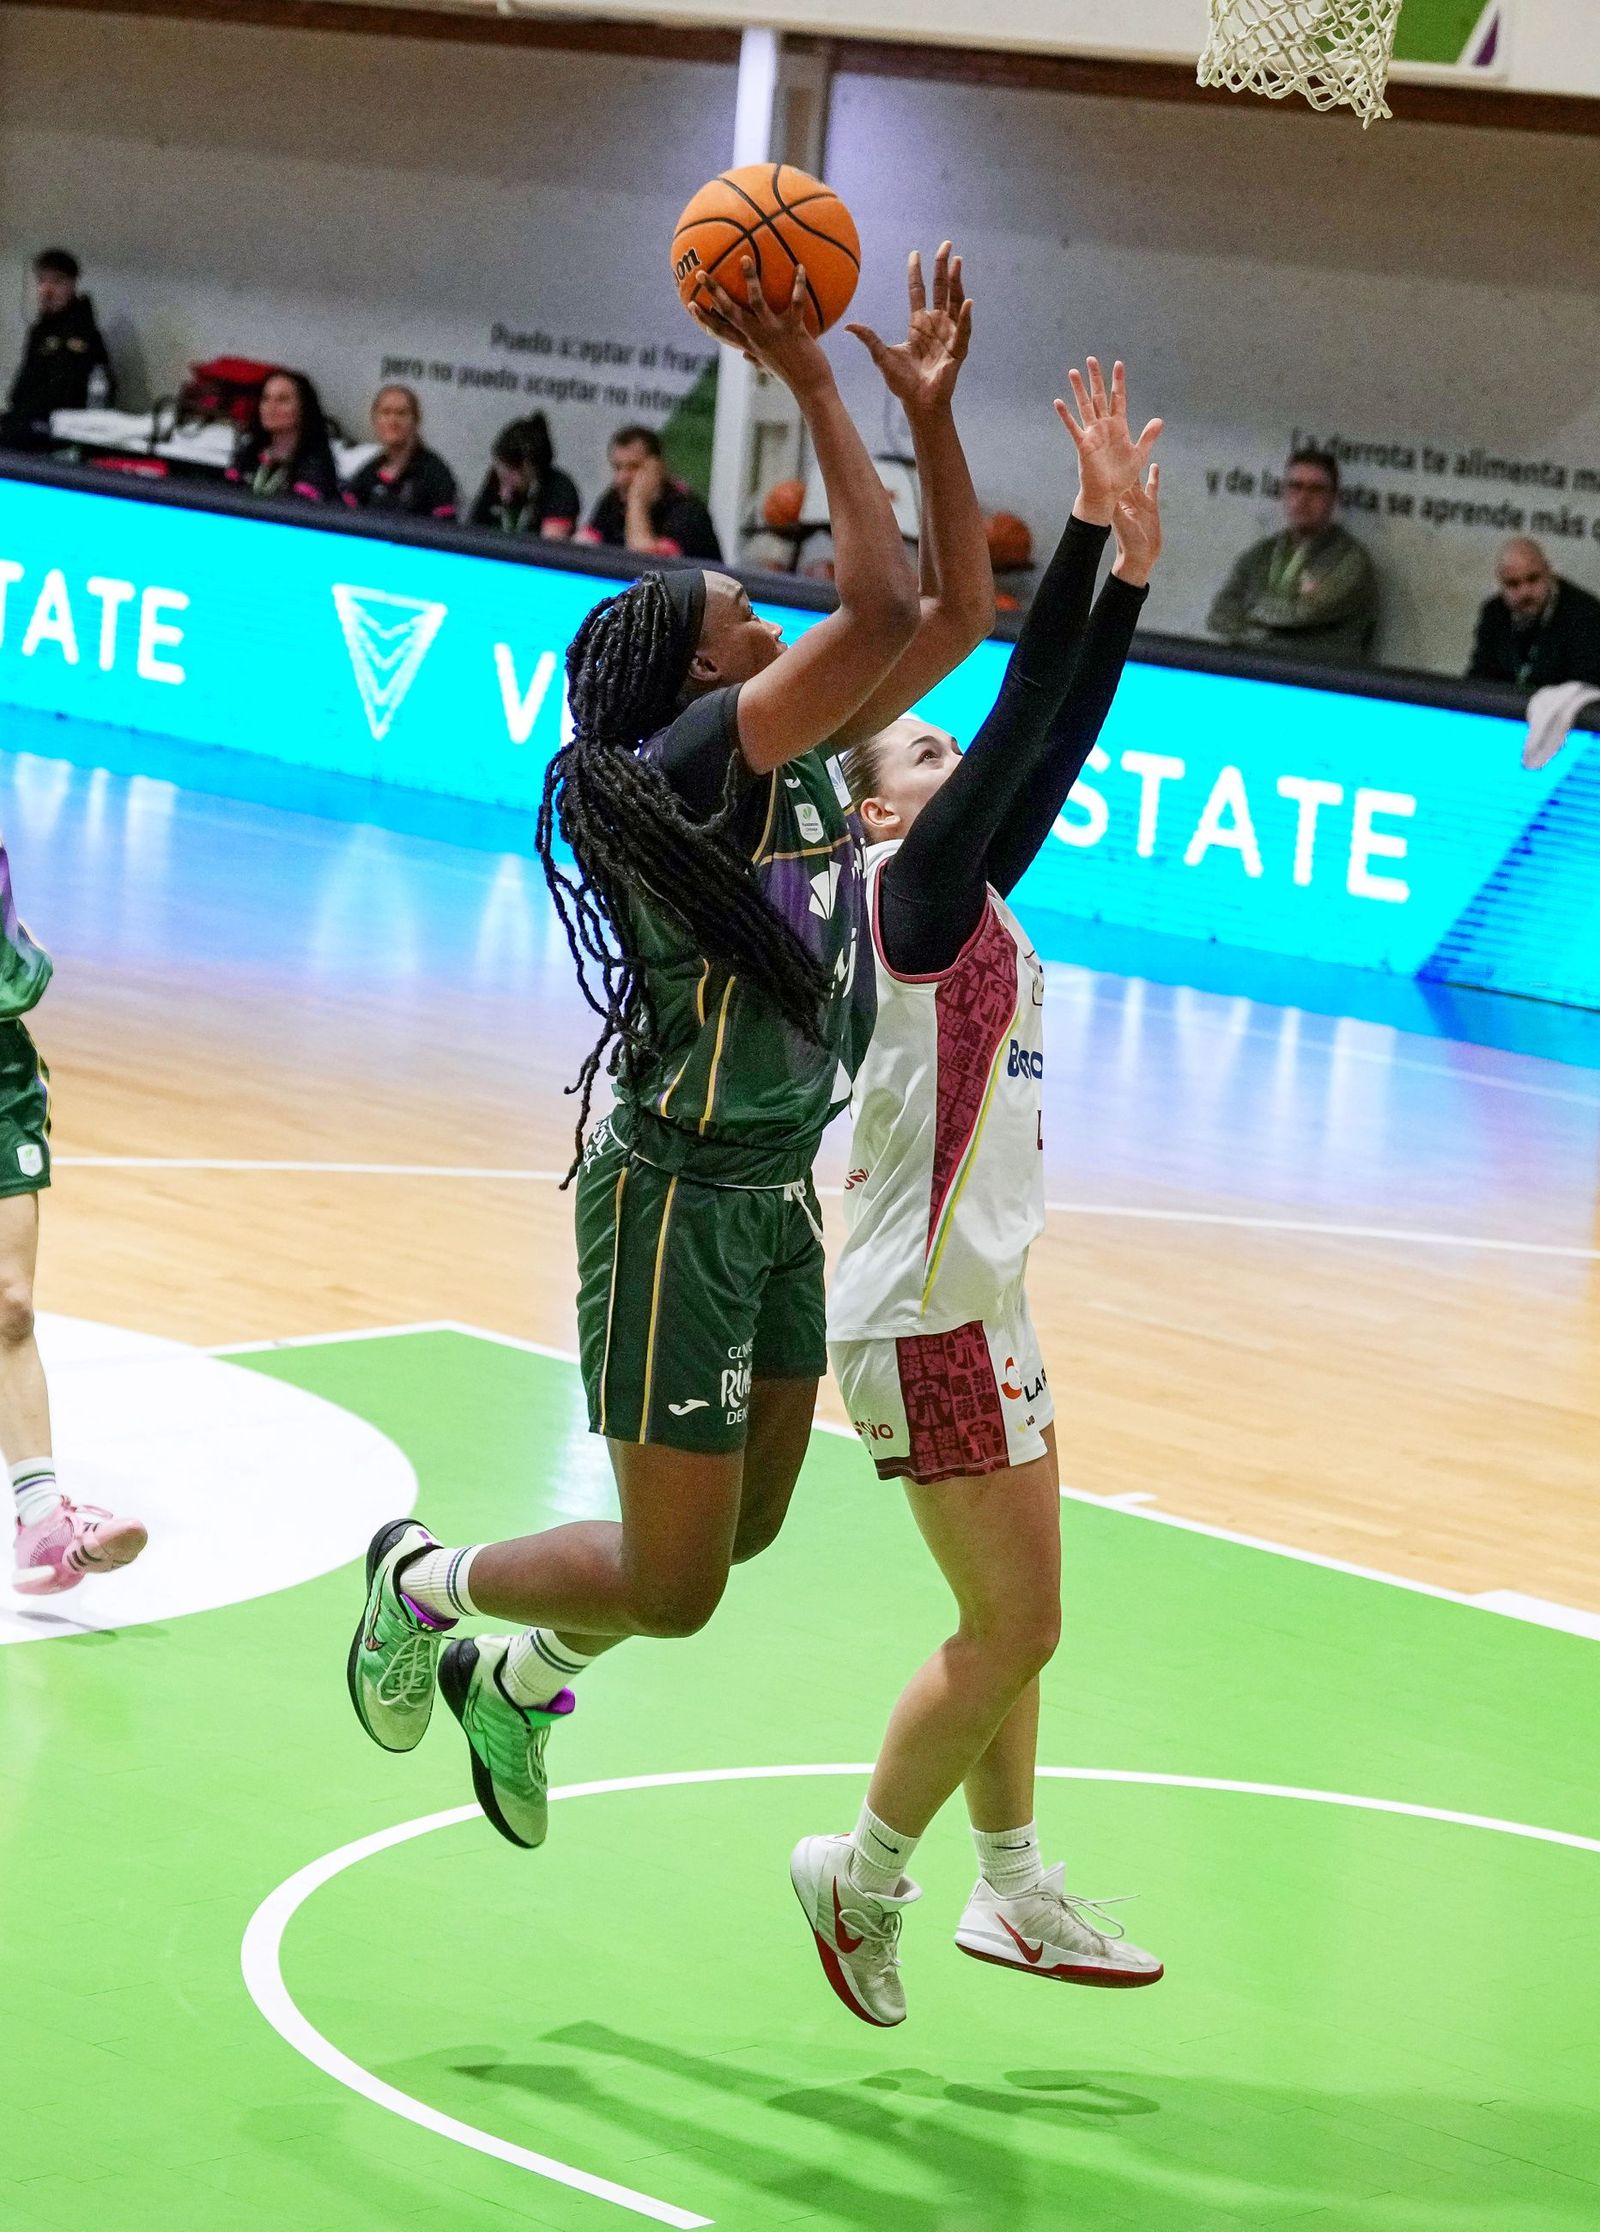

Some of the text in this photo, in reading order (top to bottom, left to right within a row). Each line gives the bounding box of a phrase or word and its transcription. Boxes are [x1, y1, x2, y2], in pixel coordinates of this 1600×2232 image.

[673, 248, 701, 287] on
[1453, 448, 1567, 490] alimenta
[1419, 493, 1525, 532] aprende
